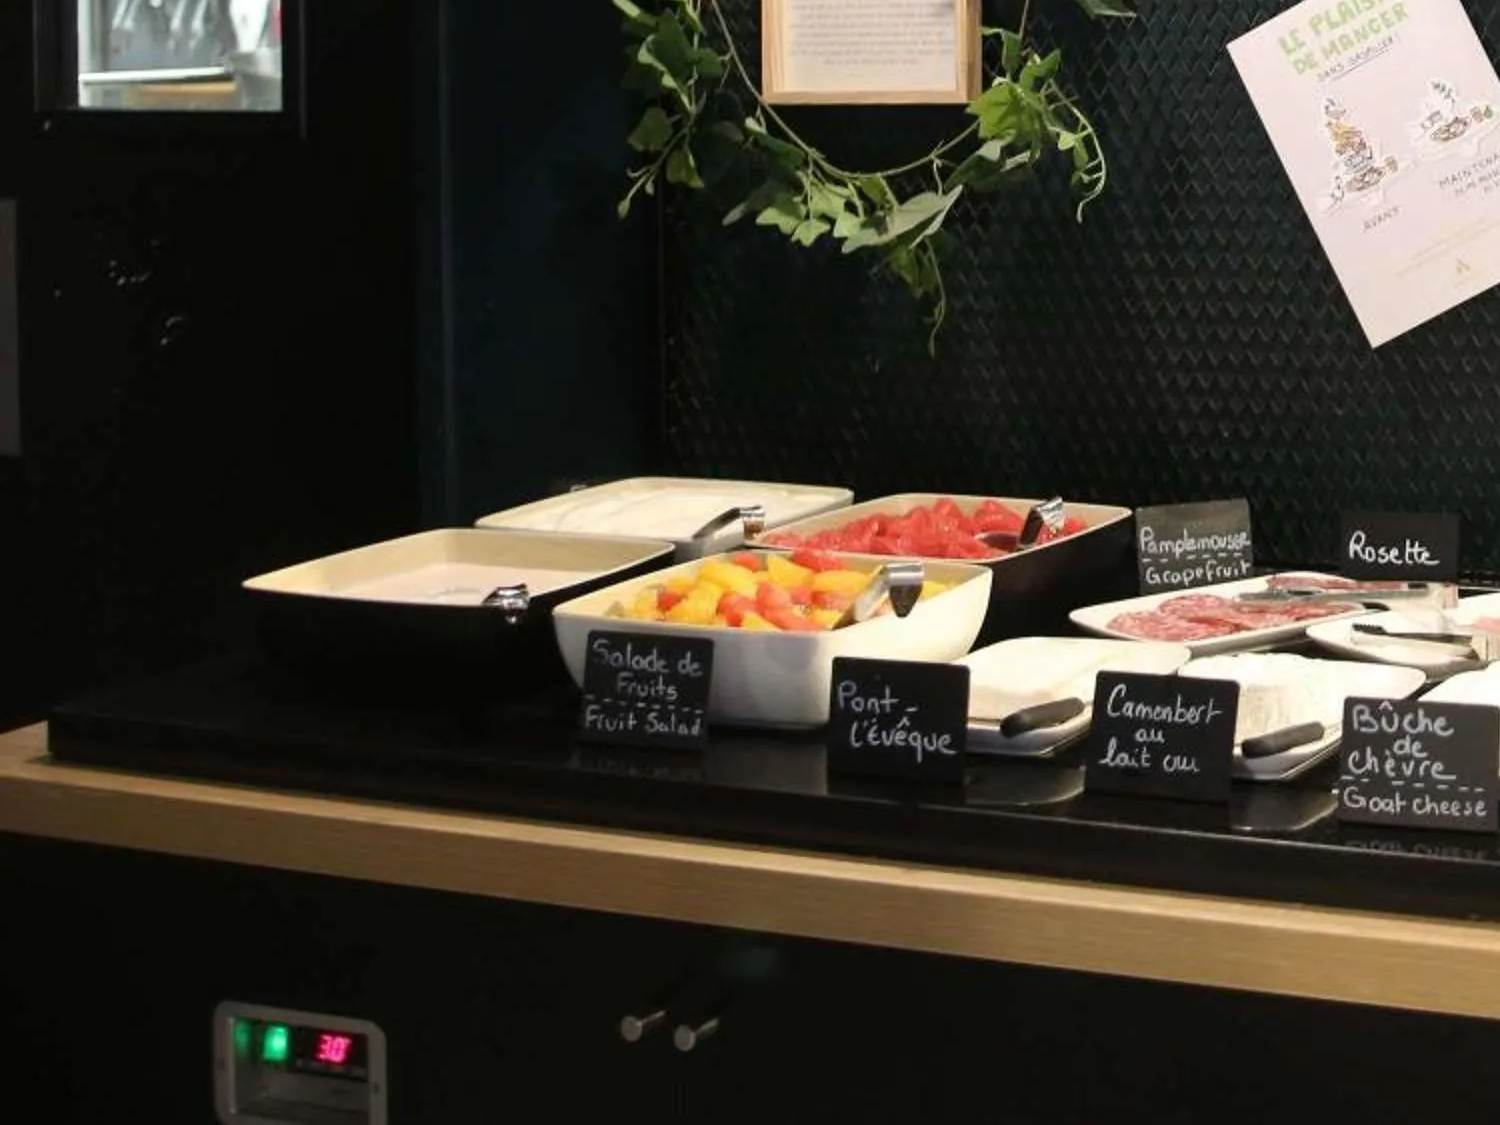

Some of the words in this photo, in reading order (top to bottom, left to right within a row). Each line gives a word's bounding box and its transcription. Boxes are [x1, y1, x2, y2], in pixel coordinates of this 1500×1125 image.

[1279, 28, 1306, 55] LE
[1292, 51, 1319, 75] DE
[1140, 526, 1251, 560] Pamplemousse
[1349, 530, 1440, 565] Rosette
[1146, 558, 1251, 587] Grapefruit
[592, 638, 670, 674] Salade
[677, 650, 703, 676] de
[617, 671, 678, 700] Fruits
[584, 704, 638, 732] Fruit
[644, 712, 701, 737] Salad
[1353, 701, 1455, 737] Bûche
[1135, 728, 1165, 744] au
[1393, 735, 1428, 759] de
[1099, 736, 1152, 768] lait
[1343, 786, 1407, 815] Goat
